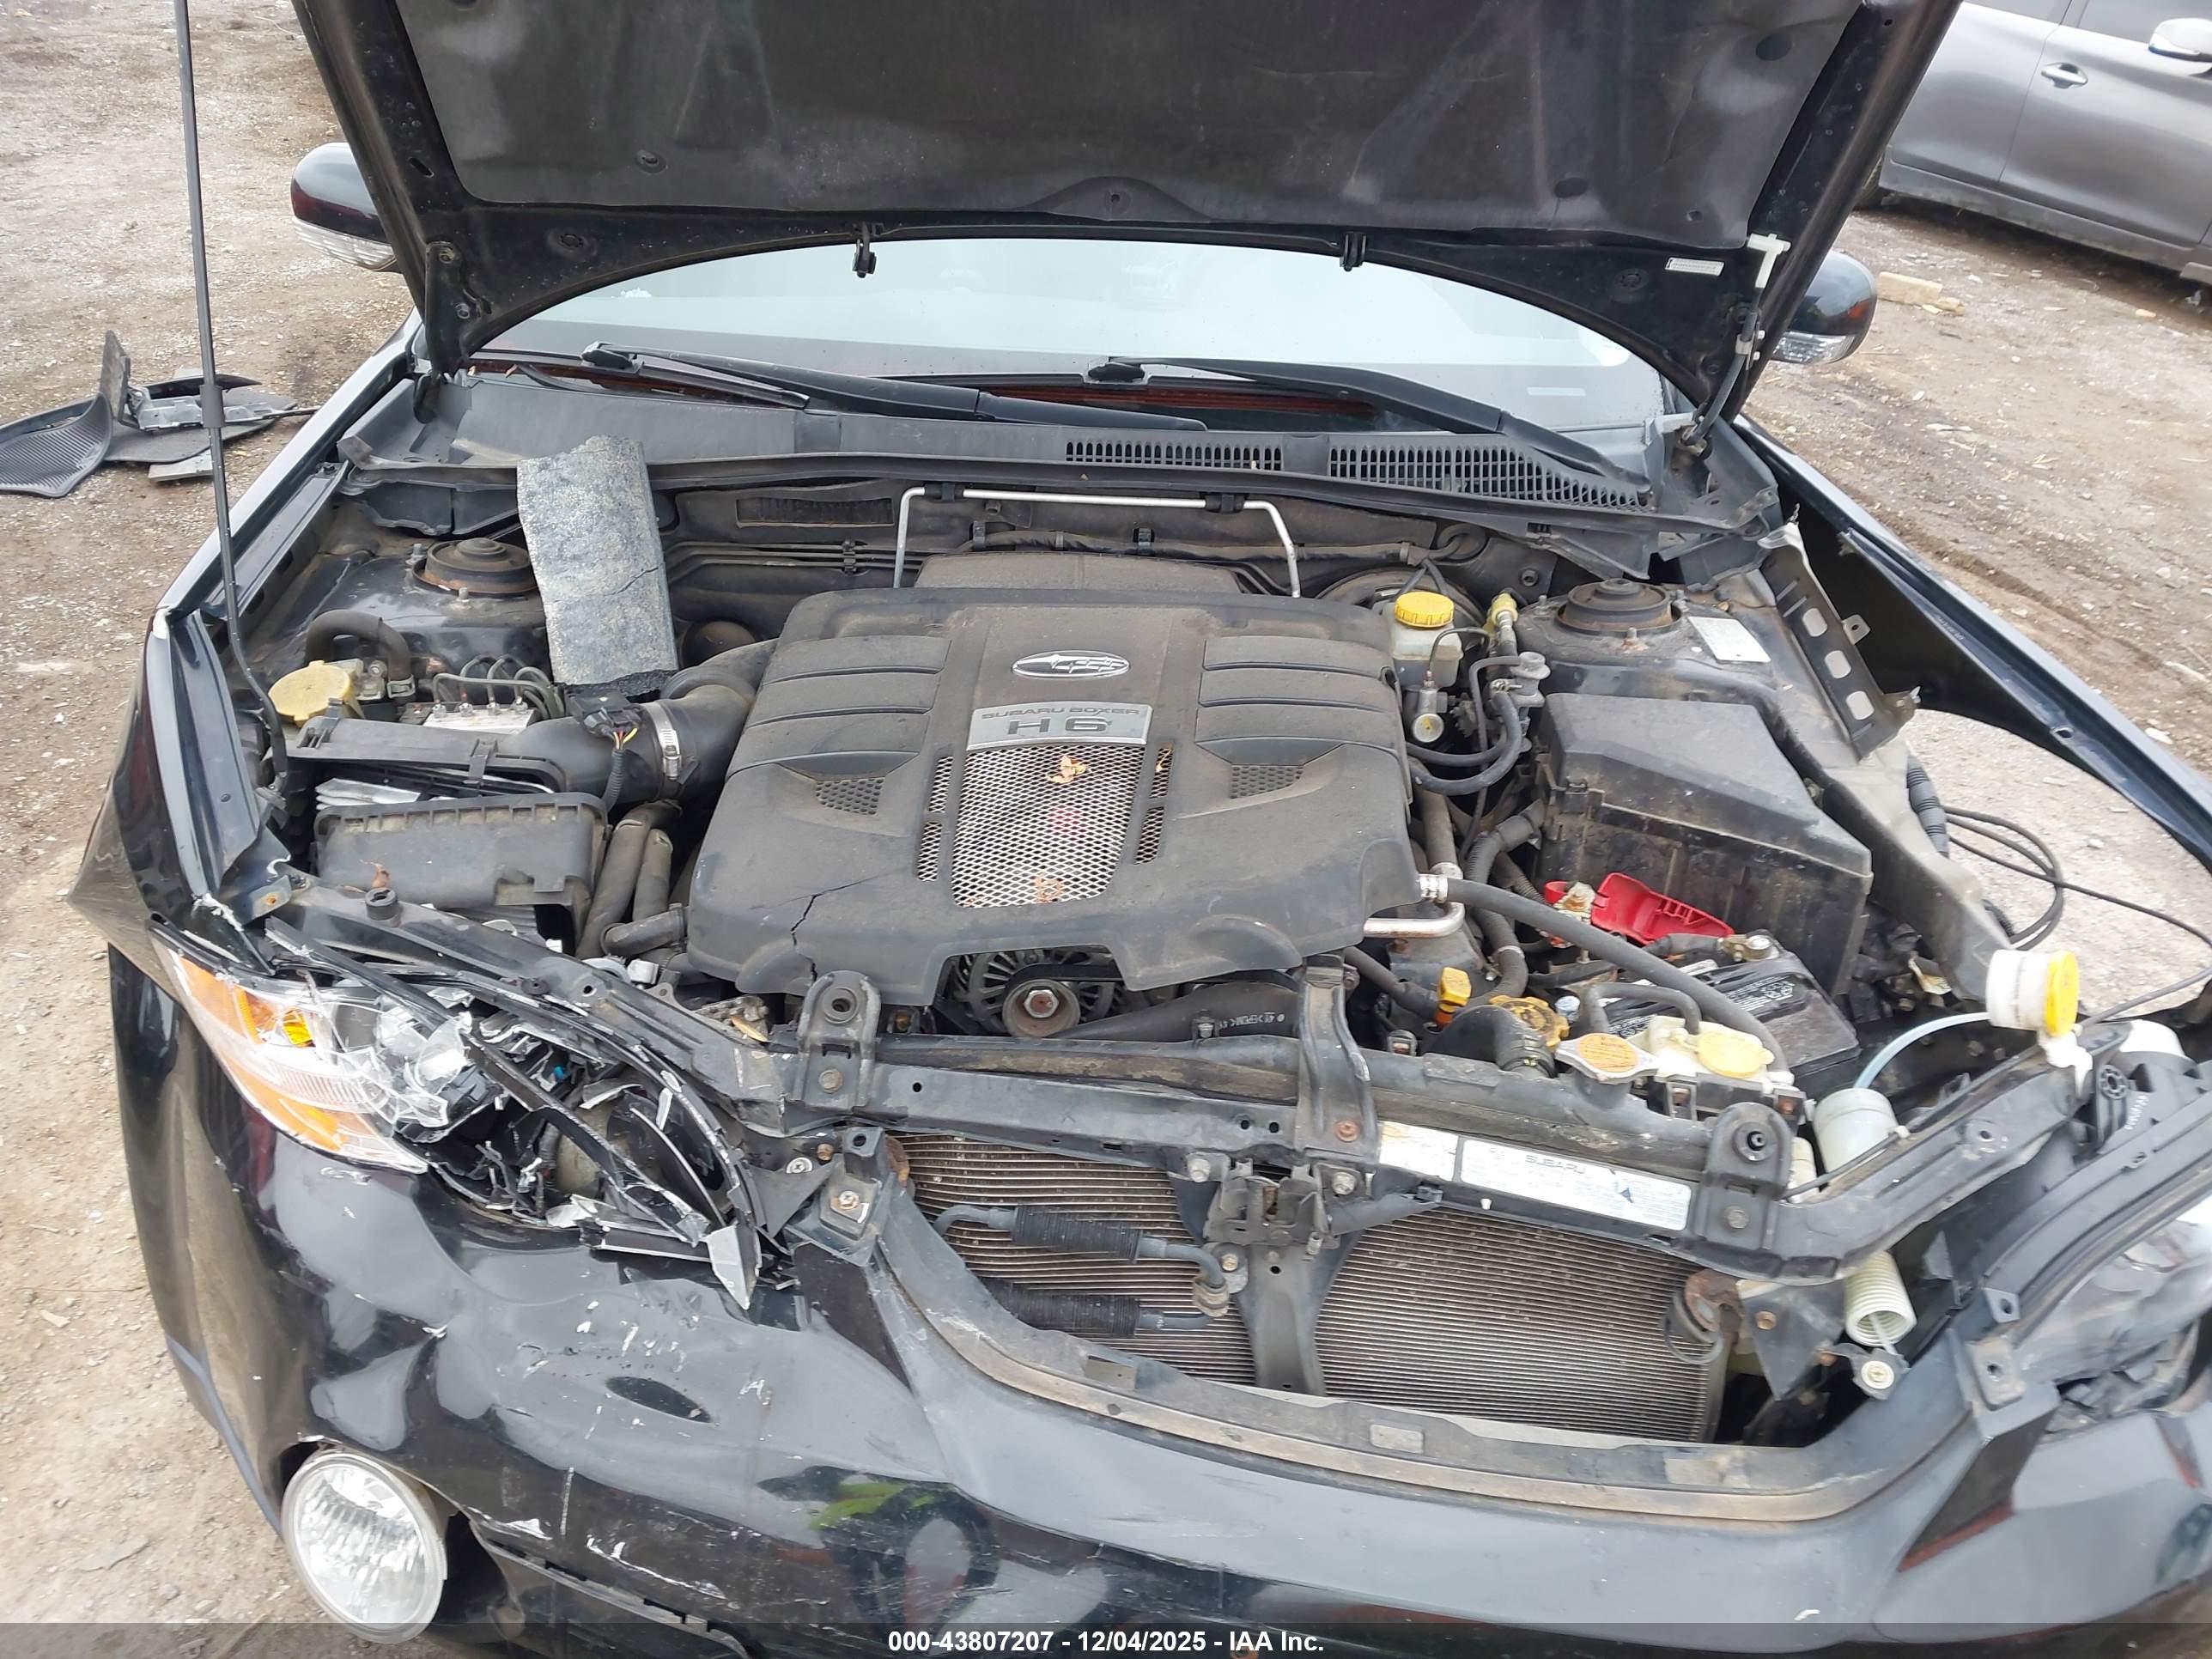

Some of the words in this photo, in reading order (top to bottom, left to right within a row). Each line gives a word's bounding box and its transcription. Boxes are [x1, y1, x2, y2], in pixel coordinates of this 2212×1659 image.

[981, 707, 1065, 720] SUBARU
[1068, 707, 1140, 716] BOXER
[1524, 1154, 1586, 1175] SUBARU
